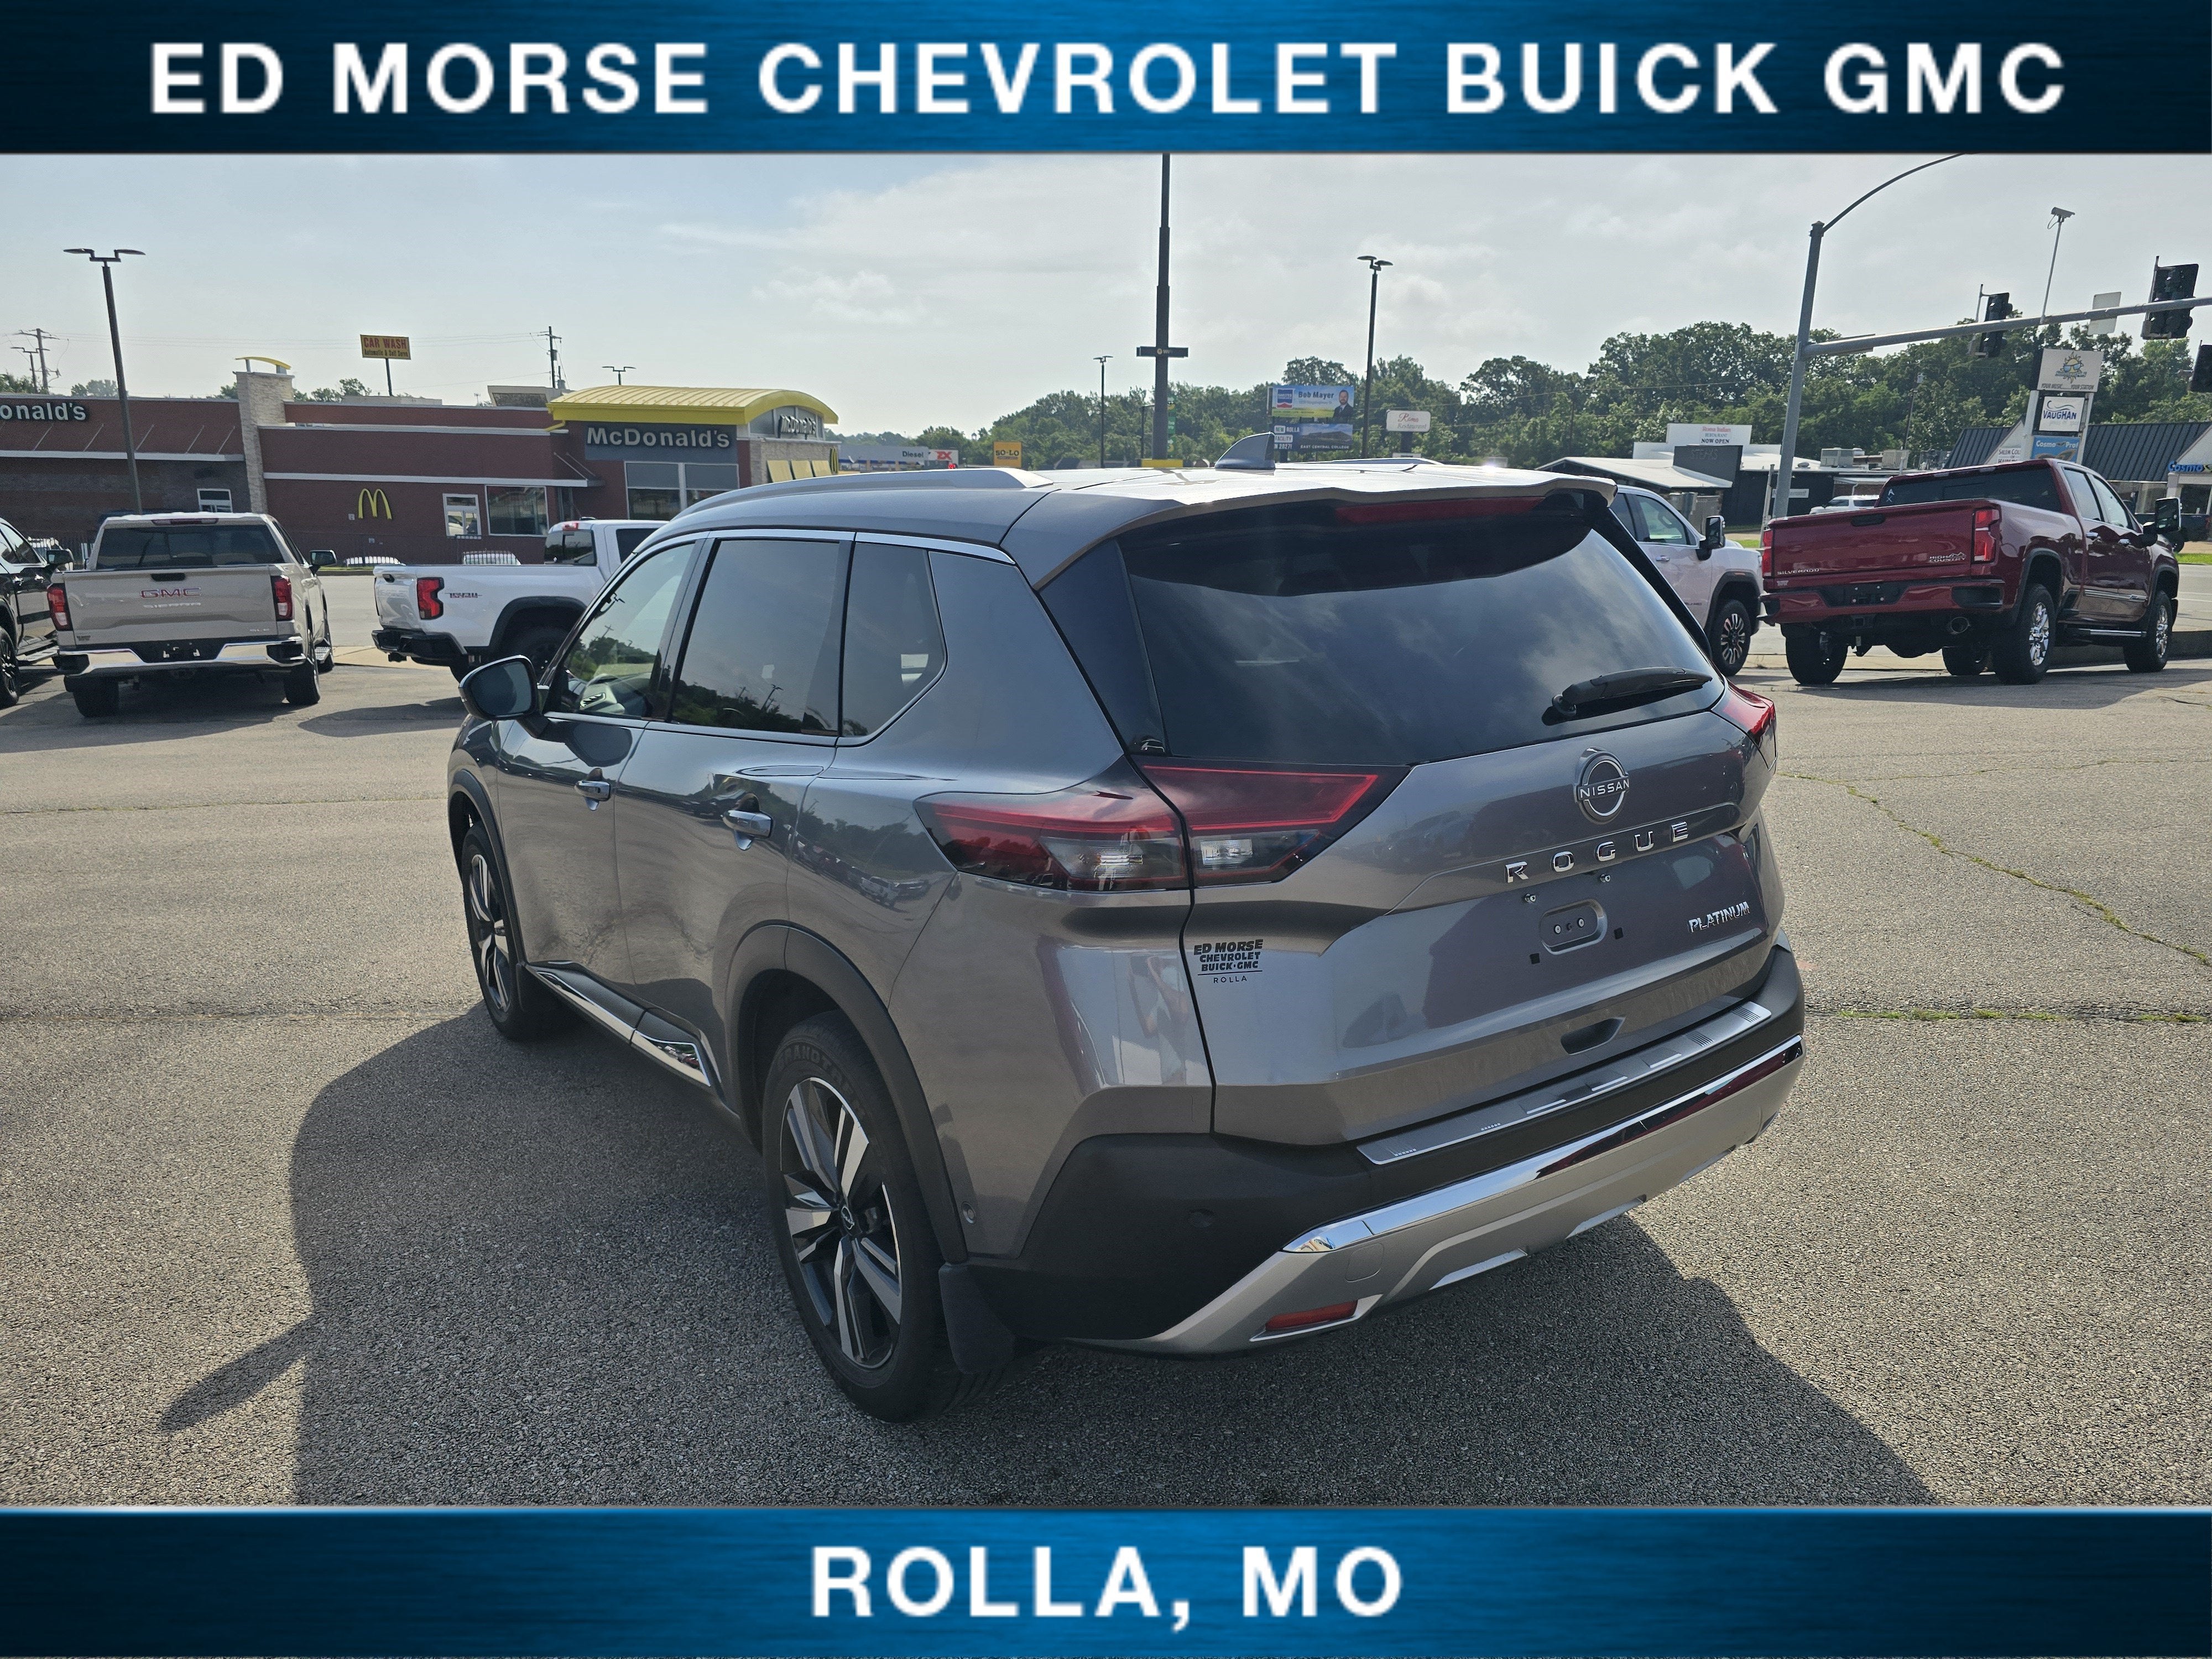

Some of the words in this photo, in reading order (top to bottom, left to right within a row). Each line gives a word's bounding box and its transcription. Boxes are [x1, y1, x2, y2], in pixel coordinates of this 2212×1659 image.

[363, 337, 380, 348] CAR
[383, 338, 406, 349] WASH
[2043, 410, 2077, 420] VAUGHAN
[587, 427, 730, 448] McDonald's
[2168, 460, 2204, 472] Cosmo
[140, 587, 201, 598] GMC
[1580, 778, 1630, 799] NISSAN
[1505, 821, 1689, 883] ROGUE
[1688, 901, 1750, 933] PLATINUM
[1193, 943, 1212, 956] ED
[1214, 939, 1264, 953] MORSE
[1199, 951, 1261, 963] CHEVROLET
[1213, 975, 1247, 984] ROLLA
